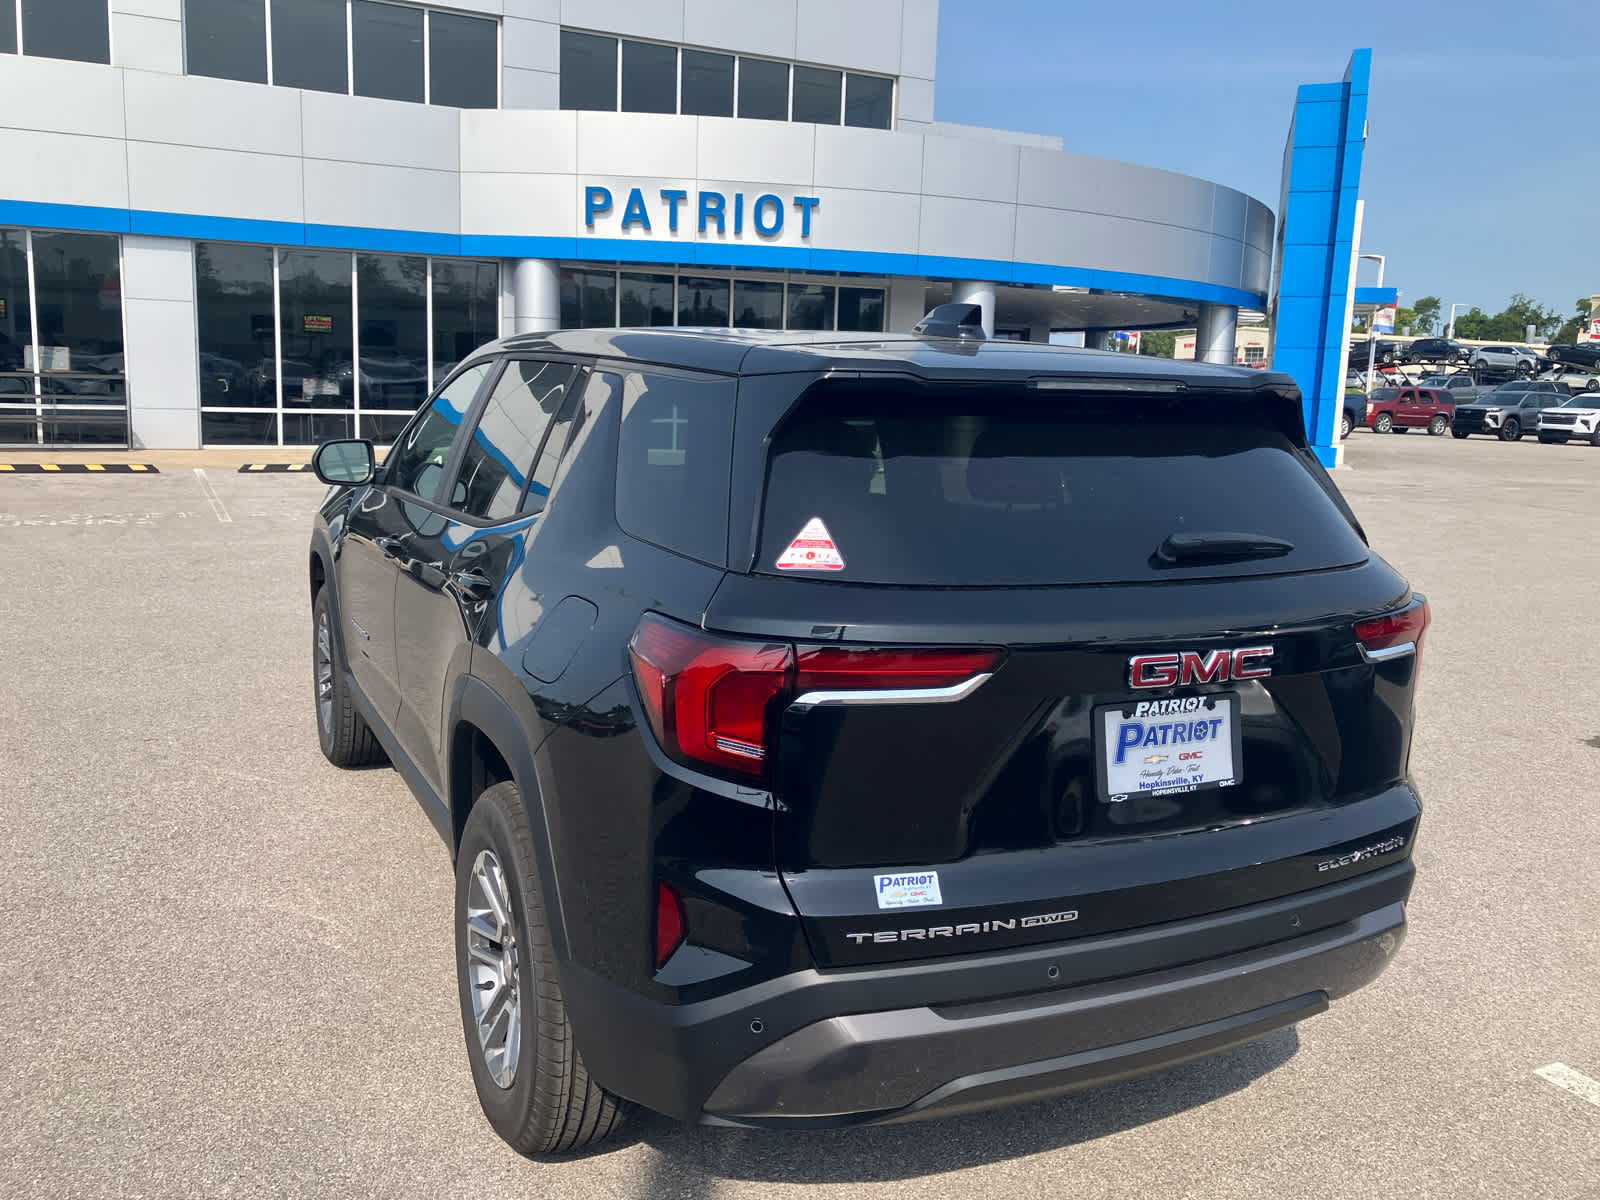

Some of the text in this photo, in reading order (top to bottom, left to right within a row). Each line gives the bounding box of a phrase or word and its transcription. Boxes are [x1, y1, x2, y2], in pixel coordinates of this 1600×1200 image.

[584, 186, 820, 238] PATRIOT
[1129, 645, 1274, 689] GMC
[1135, 696, 1207, 717] PATRIOT
[1113, 718, 1223, 765] PATRIOT
[1178, 751, 1203, 761] GMC
[1139, 774, 1204, 789] Hopkinsville, KY
[1218, 779, 1236, 788] GMC
[879, 874, 934, 894] PATRIOT
[846, 918, 1016, 945] TERRAIN
